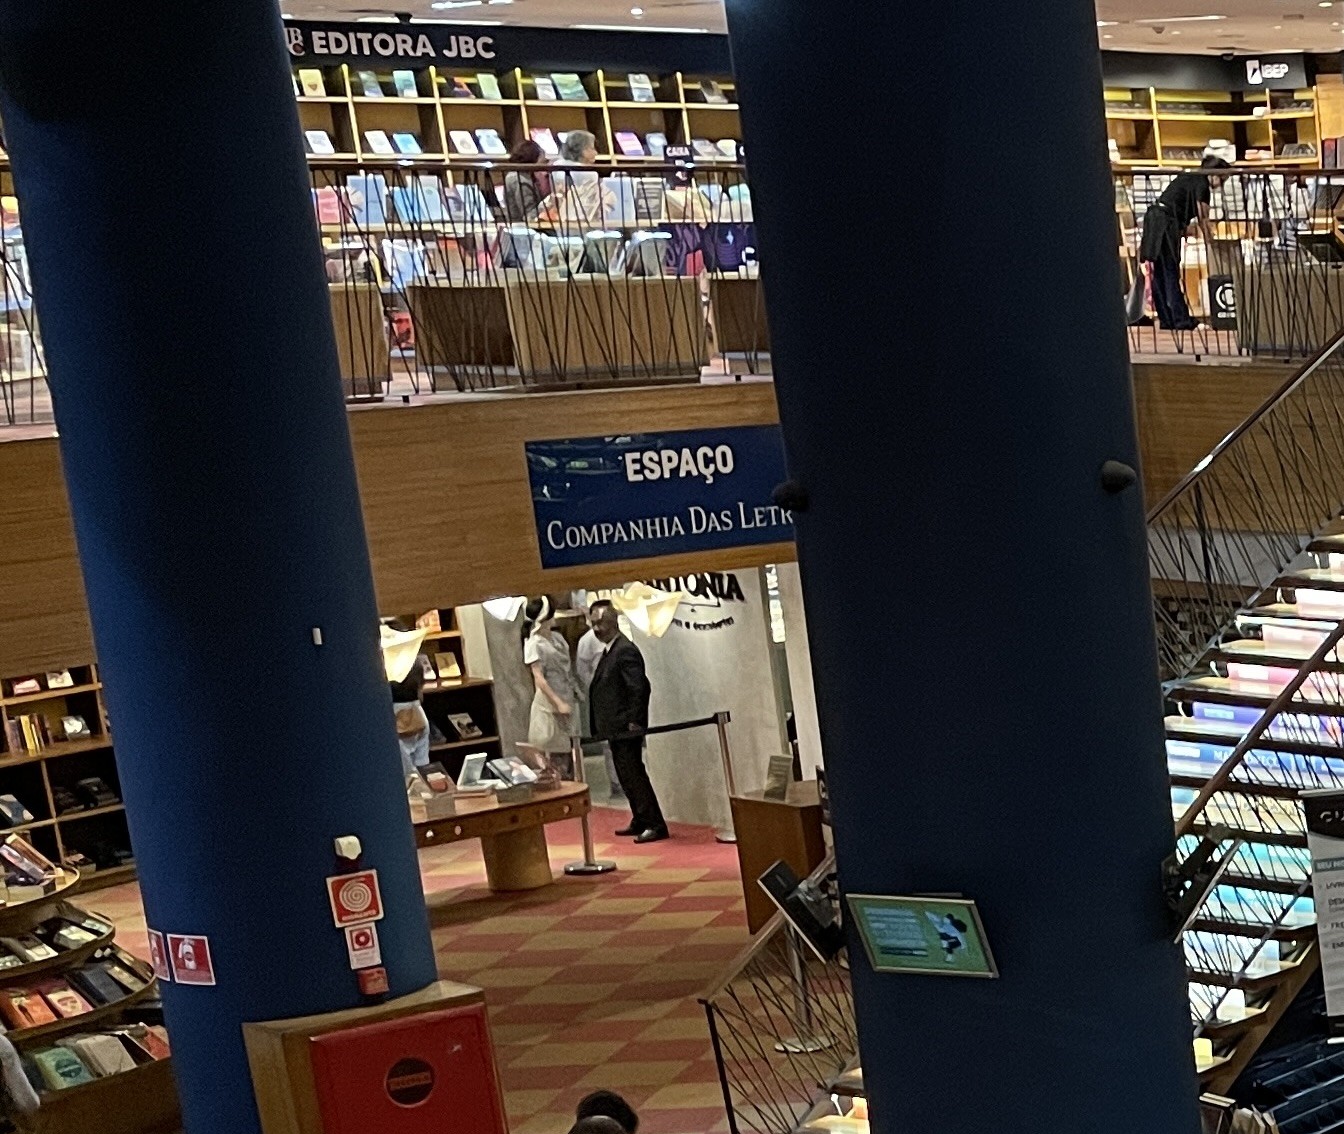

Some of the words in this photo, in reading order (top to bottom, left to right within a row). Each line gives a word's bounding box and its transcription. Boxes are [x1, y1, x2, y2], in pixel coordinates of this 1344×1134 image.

[311, 31, 436, 57] EDITORA
[443, 35, 496, 59] JBC
[624, 444, 734, 484] ESPAÇO
